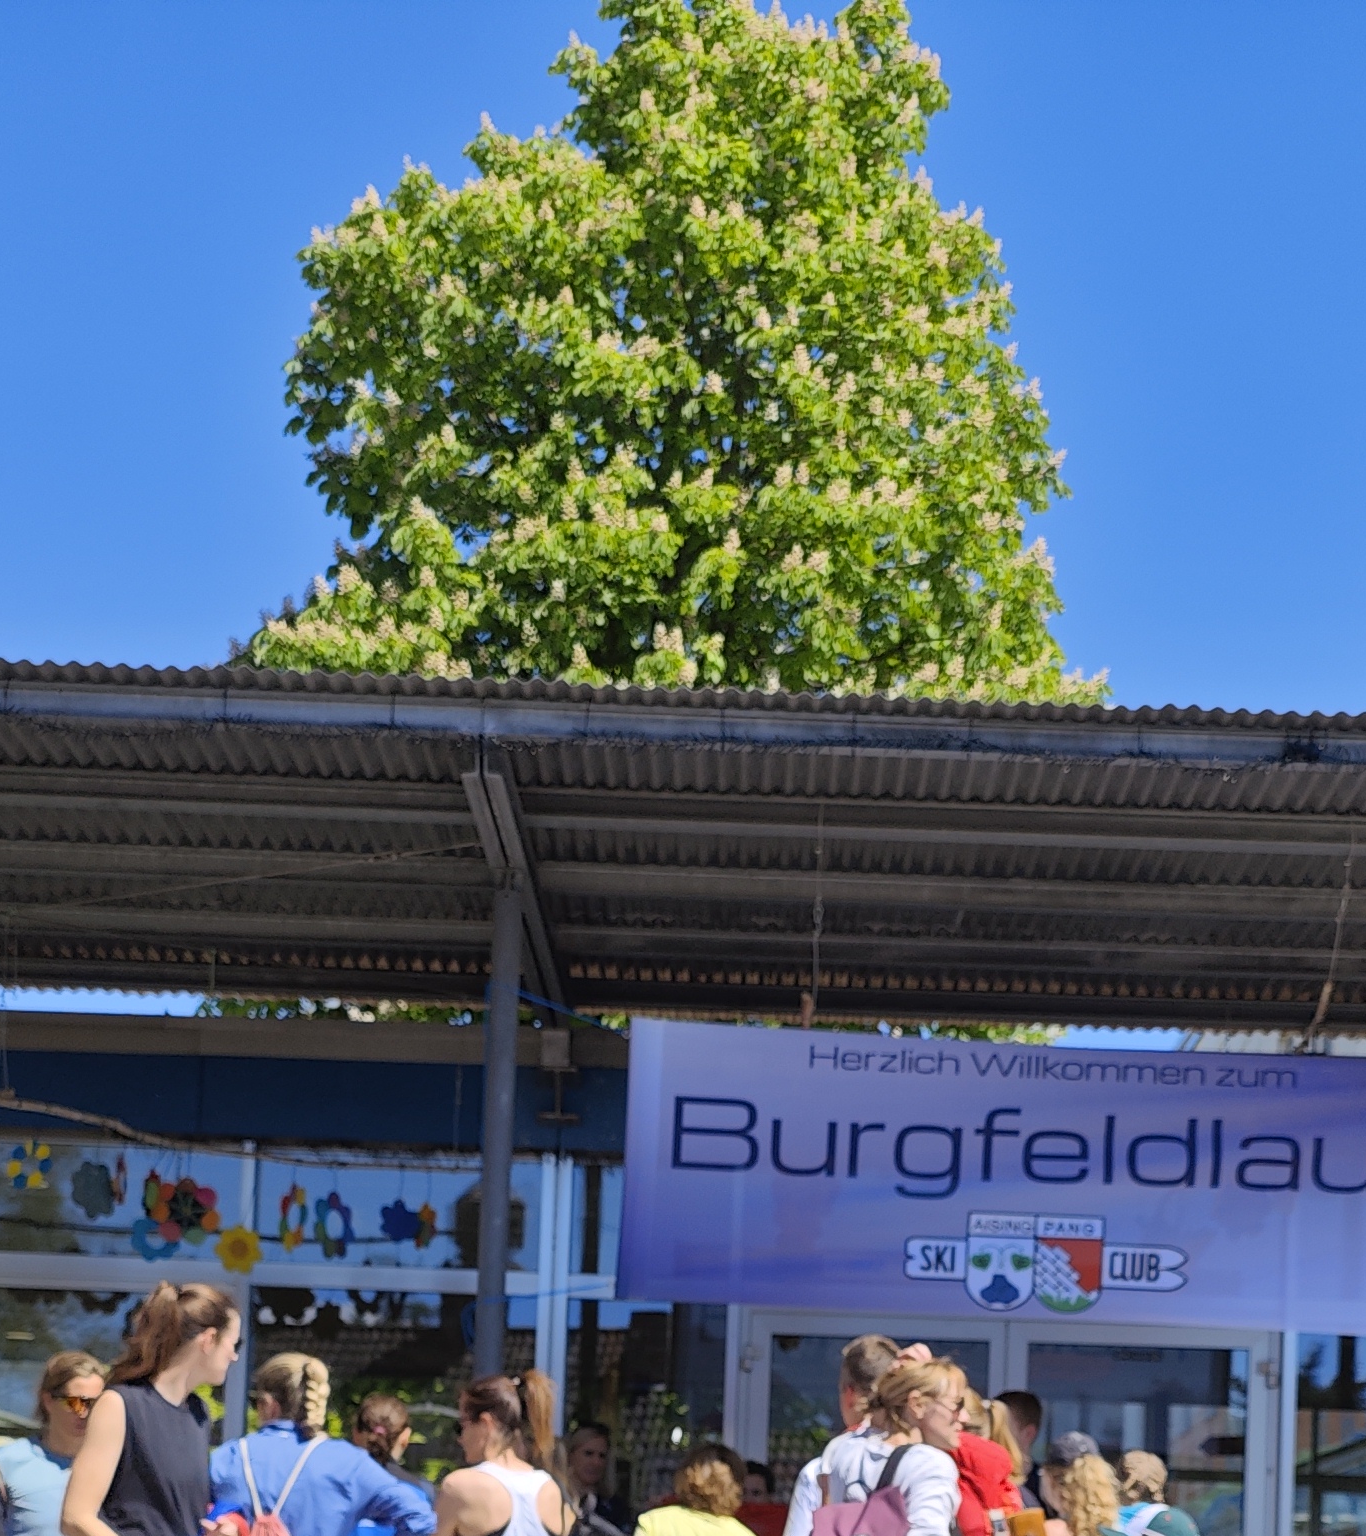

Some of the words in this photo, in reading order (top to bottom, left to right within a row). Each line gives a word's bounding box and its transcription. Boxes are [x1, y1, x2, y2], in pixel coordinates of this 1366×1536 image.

[807, 1043, 962, 1076] Herzlich
[970, 1050, 1206, 1087] Willkommen
[1215, 1066, 1299, 1089] zum
[918, 1244, 956, 1273] SKI
[1108, 1250, 1161, 1283] CLUB
